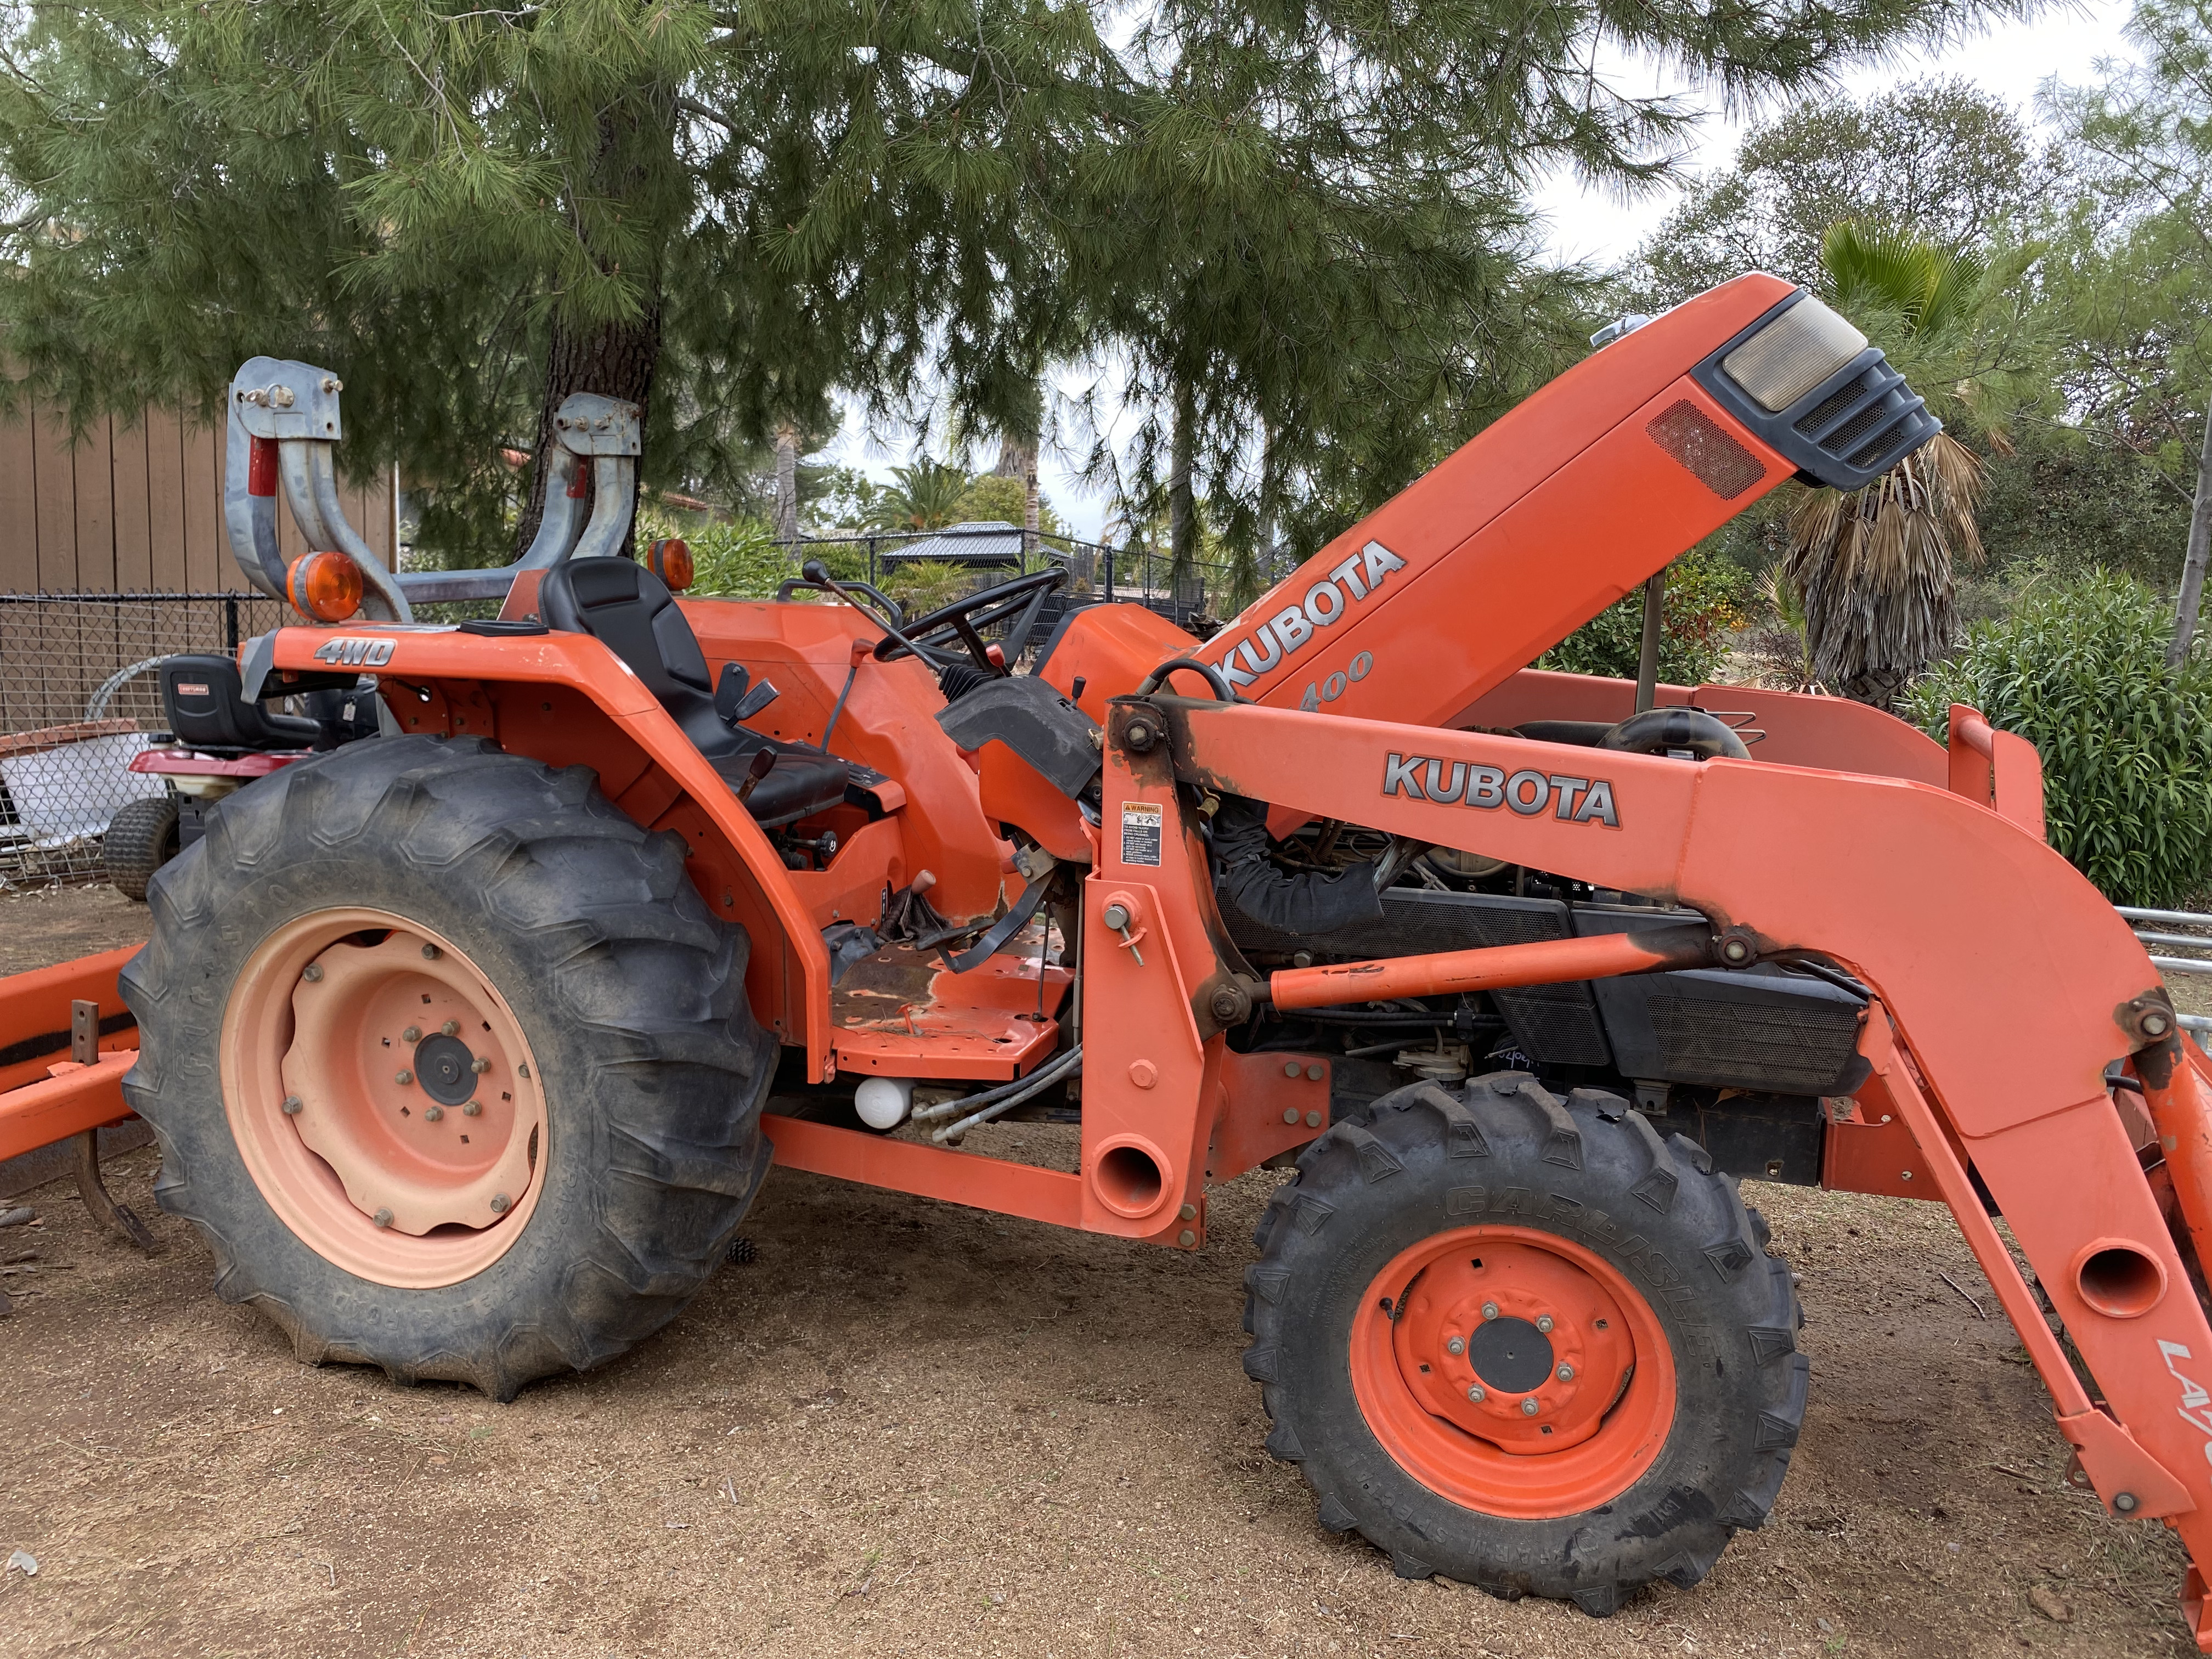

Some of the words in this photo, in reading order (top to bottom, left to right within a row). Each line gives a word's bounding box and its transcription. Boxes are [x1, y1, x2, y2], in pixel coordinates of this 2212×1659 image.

[1209, 538, 1407, 696] KUBOTA
[314, 639, 396, 667] 4WD
[1286, 651, 1373, 713] 400
[1131, 805, 1159, 813] WARNING
[1383, 753, 1620, 826] KUBOTA
[1446, 1186, 1721, 1357] CARLISLE
